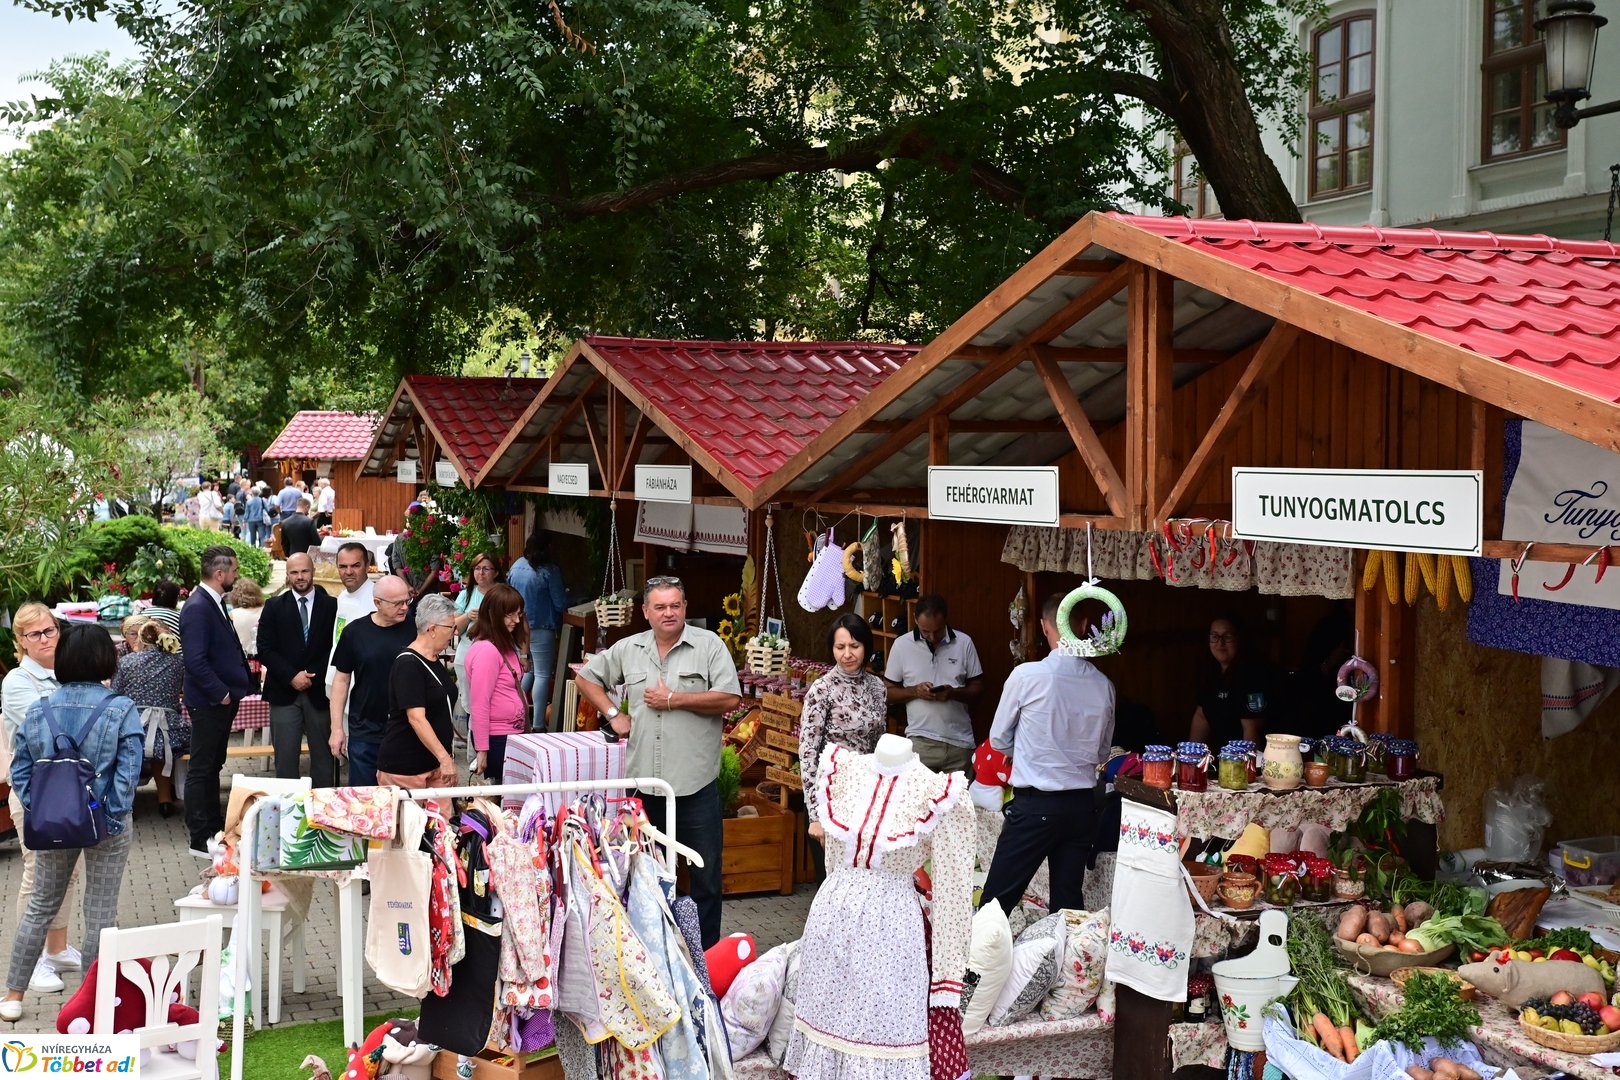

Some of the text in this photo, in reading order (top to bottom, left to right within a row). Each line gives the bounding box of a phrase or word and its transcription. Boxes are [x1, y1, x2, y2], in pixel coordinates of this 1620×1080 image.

[557, 474, 578, 485] NAGYECSED
[646, 475, 678, 491] FÁBIÁNHÁZA
[946, 483, 1035, 506] FEHÉRGYARMAT
[1258, 494, 1446, 526] TUNYOGMATOLCS
